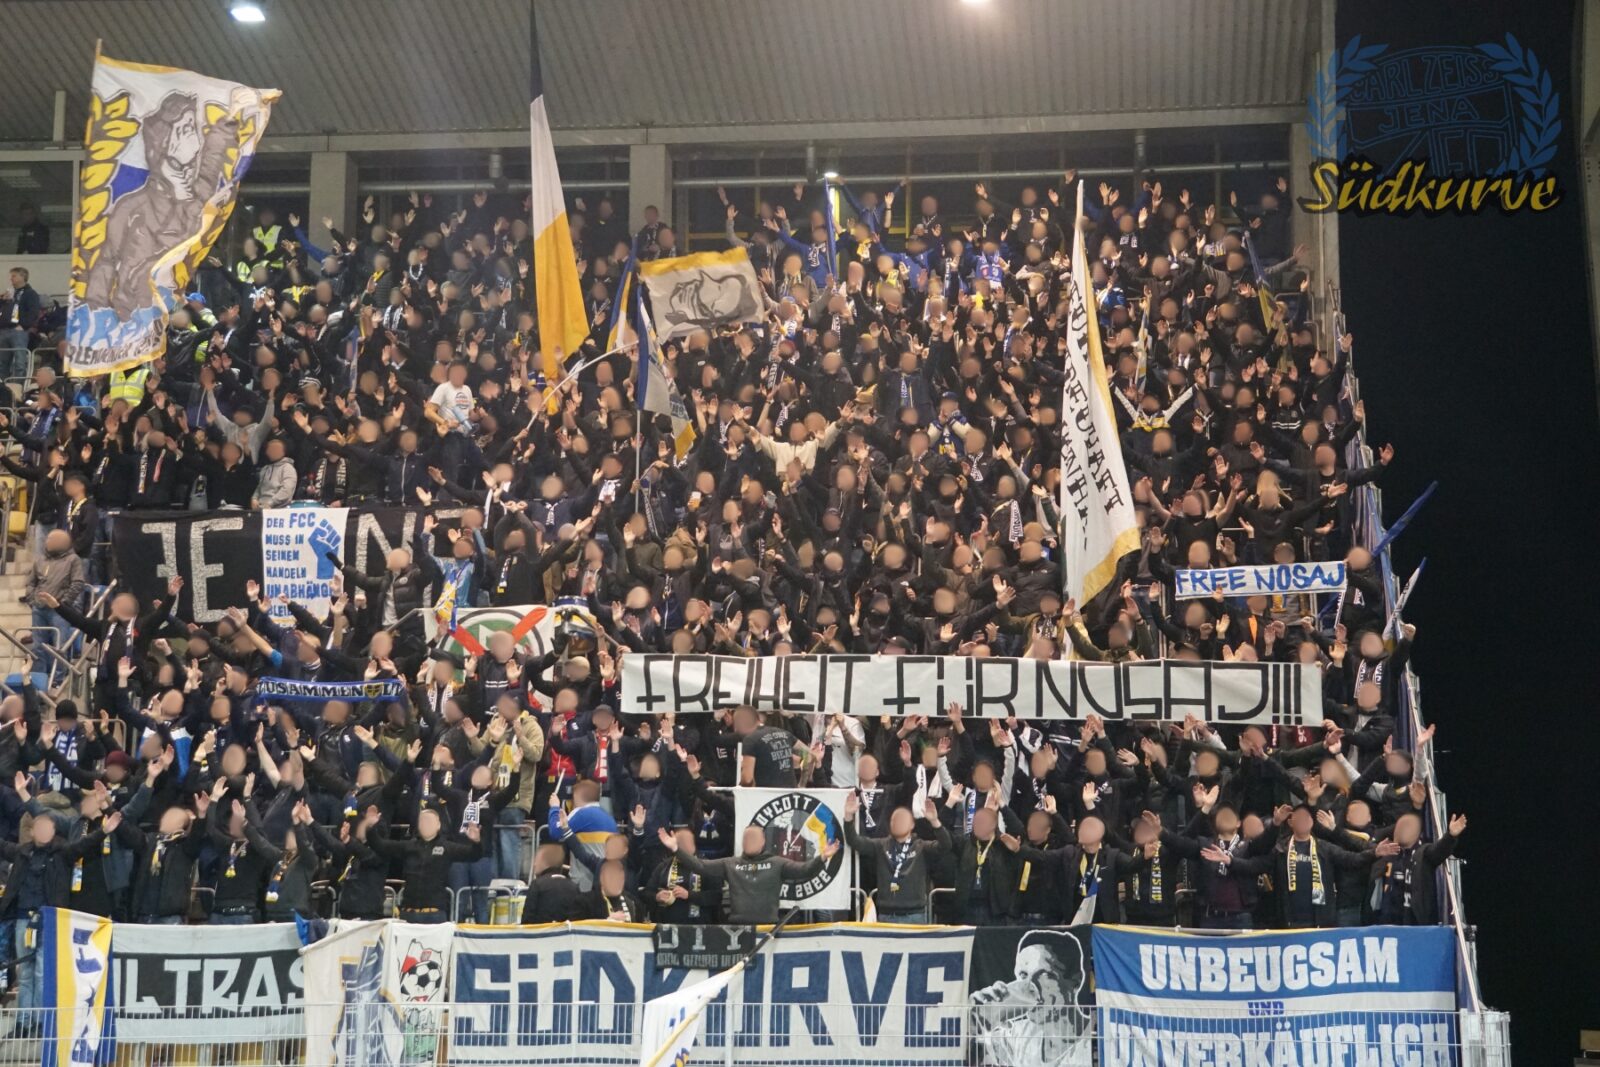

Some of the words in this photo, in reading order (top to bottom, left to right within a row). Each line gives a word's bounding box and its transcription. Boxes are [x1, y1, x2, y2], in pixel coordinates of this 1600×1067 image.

[266, 517, 285, 529] DER
[289, 512, 316, 529] FCC
[265, 534, 291, 546] MUSS
[295, 534, 305, 545] IN
[265, 566, 307, 580] HANDELN
[1175, 568, 1247, 594] FREE
[1253, 562, 1346, 592] NOSAJ
[636, 653, 871, 713] FREIHEIT
[755, 795, 812, 827] OYCOTT
[1138, 937, 1399, 993] UNBEUGSAM
[1247, 1001, 1286, 1017] UND
